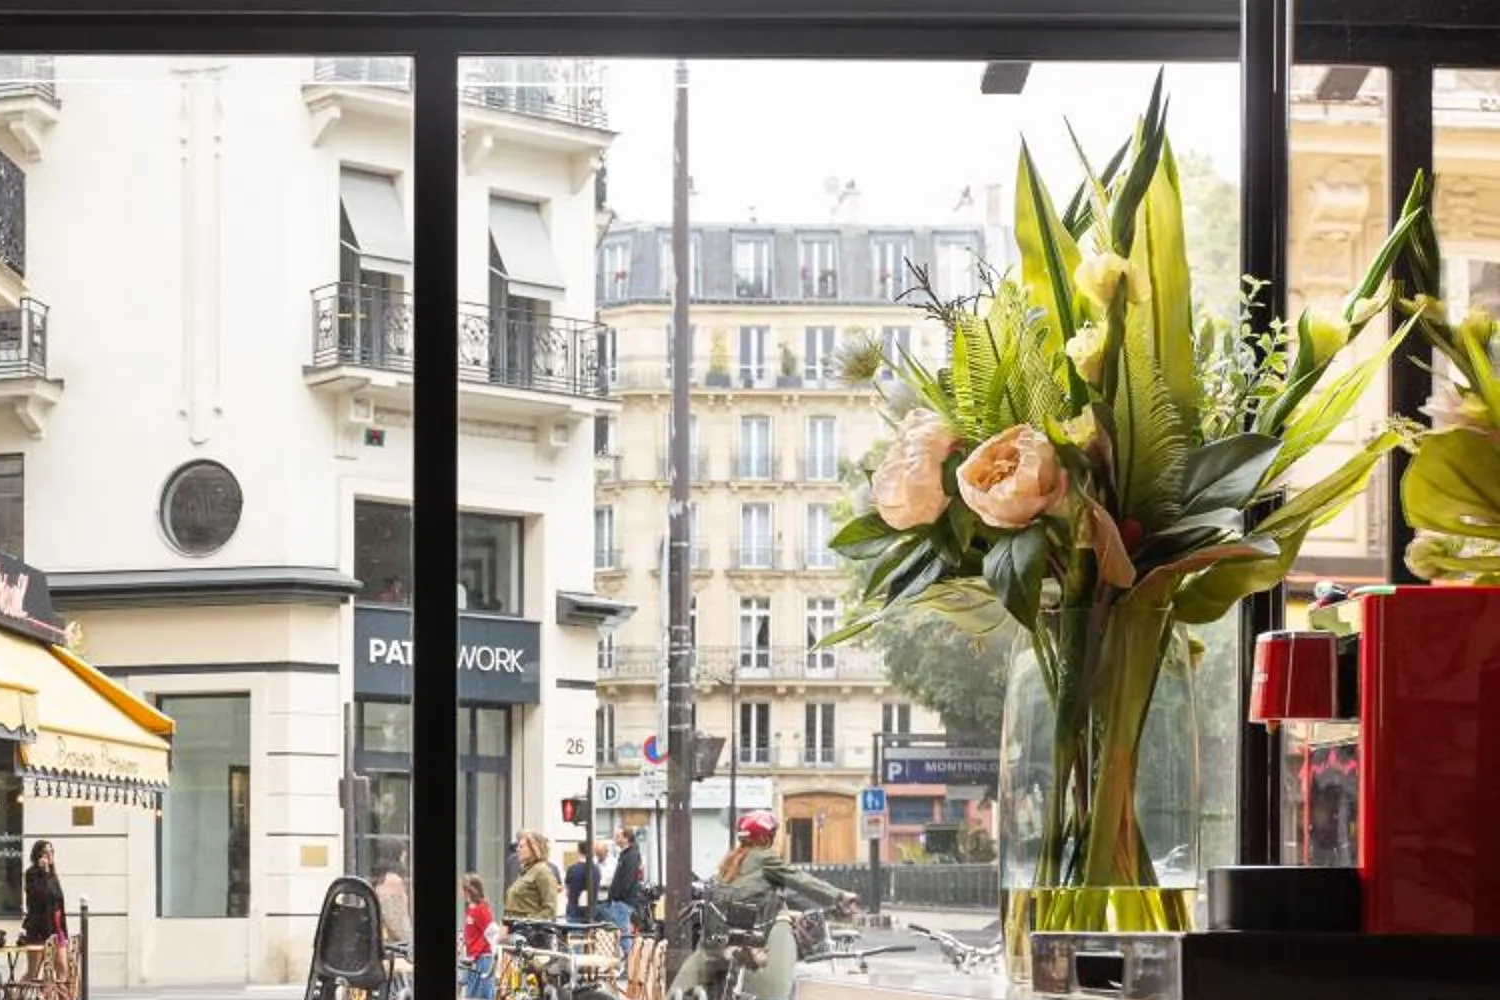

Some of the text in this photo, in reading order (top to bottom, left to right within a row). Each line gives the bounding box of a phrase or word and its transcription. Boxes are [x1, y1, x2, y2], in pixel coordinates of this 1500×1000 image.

[369, 637, 525, 673] PATWORK
[566, 737, 585, 755] 26
[887, 761, 998, 781] P MONTHOLO
